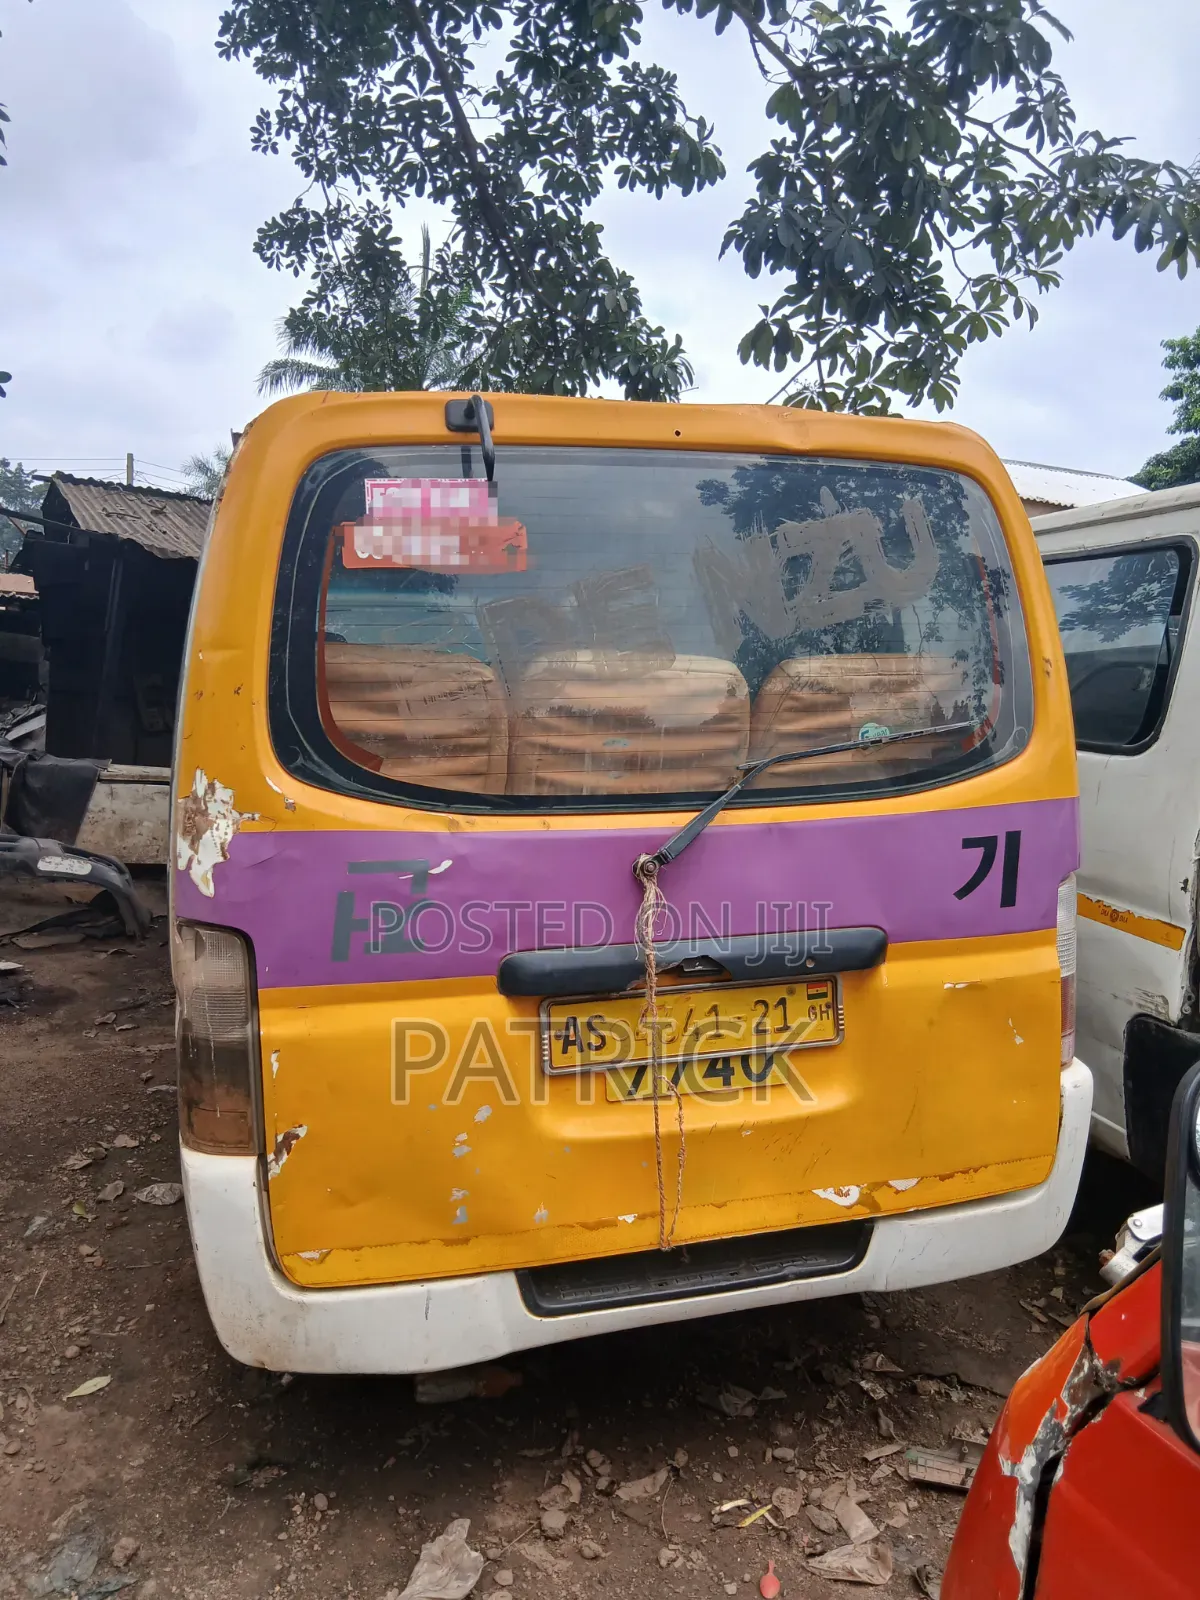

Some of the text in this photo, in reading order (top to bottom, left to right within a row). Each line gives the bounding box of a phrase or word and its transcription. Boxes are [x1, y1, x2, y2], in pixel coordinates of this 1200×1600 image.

[953, 830, 1021, 908] 기
[561, 1014, 607, 1055] AS
[807, 1003, 831, 1022] GH
